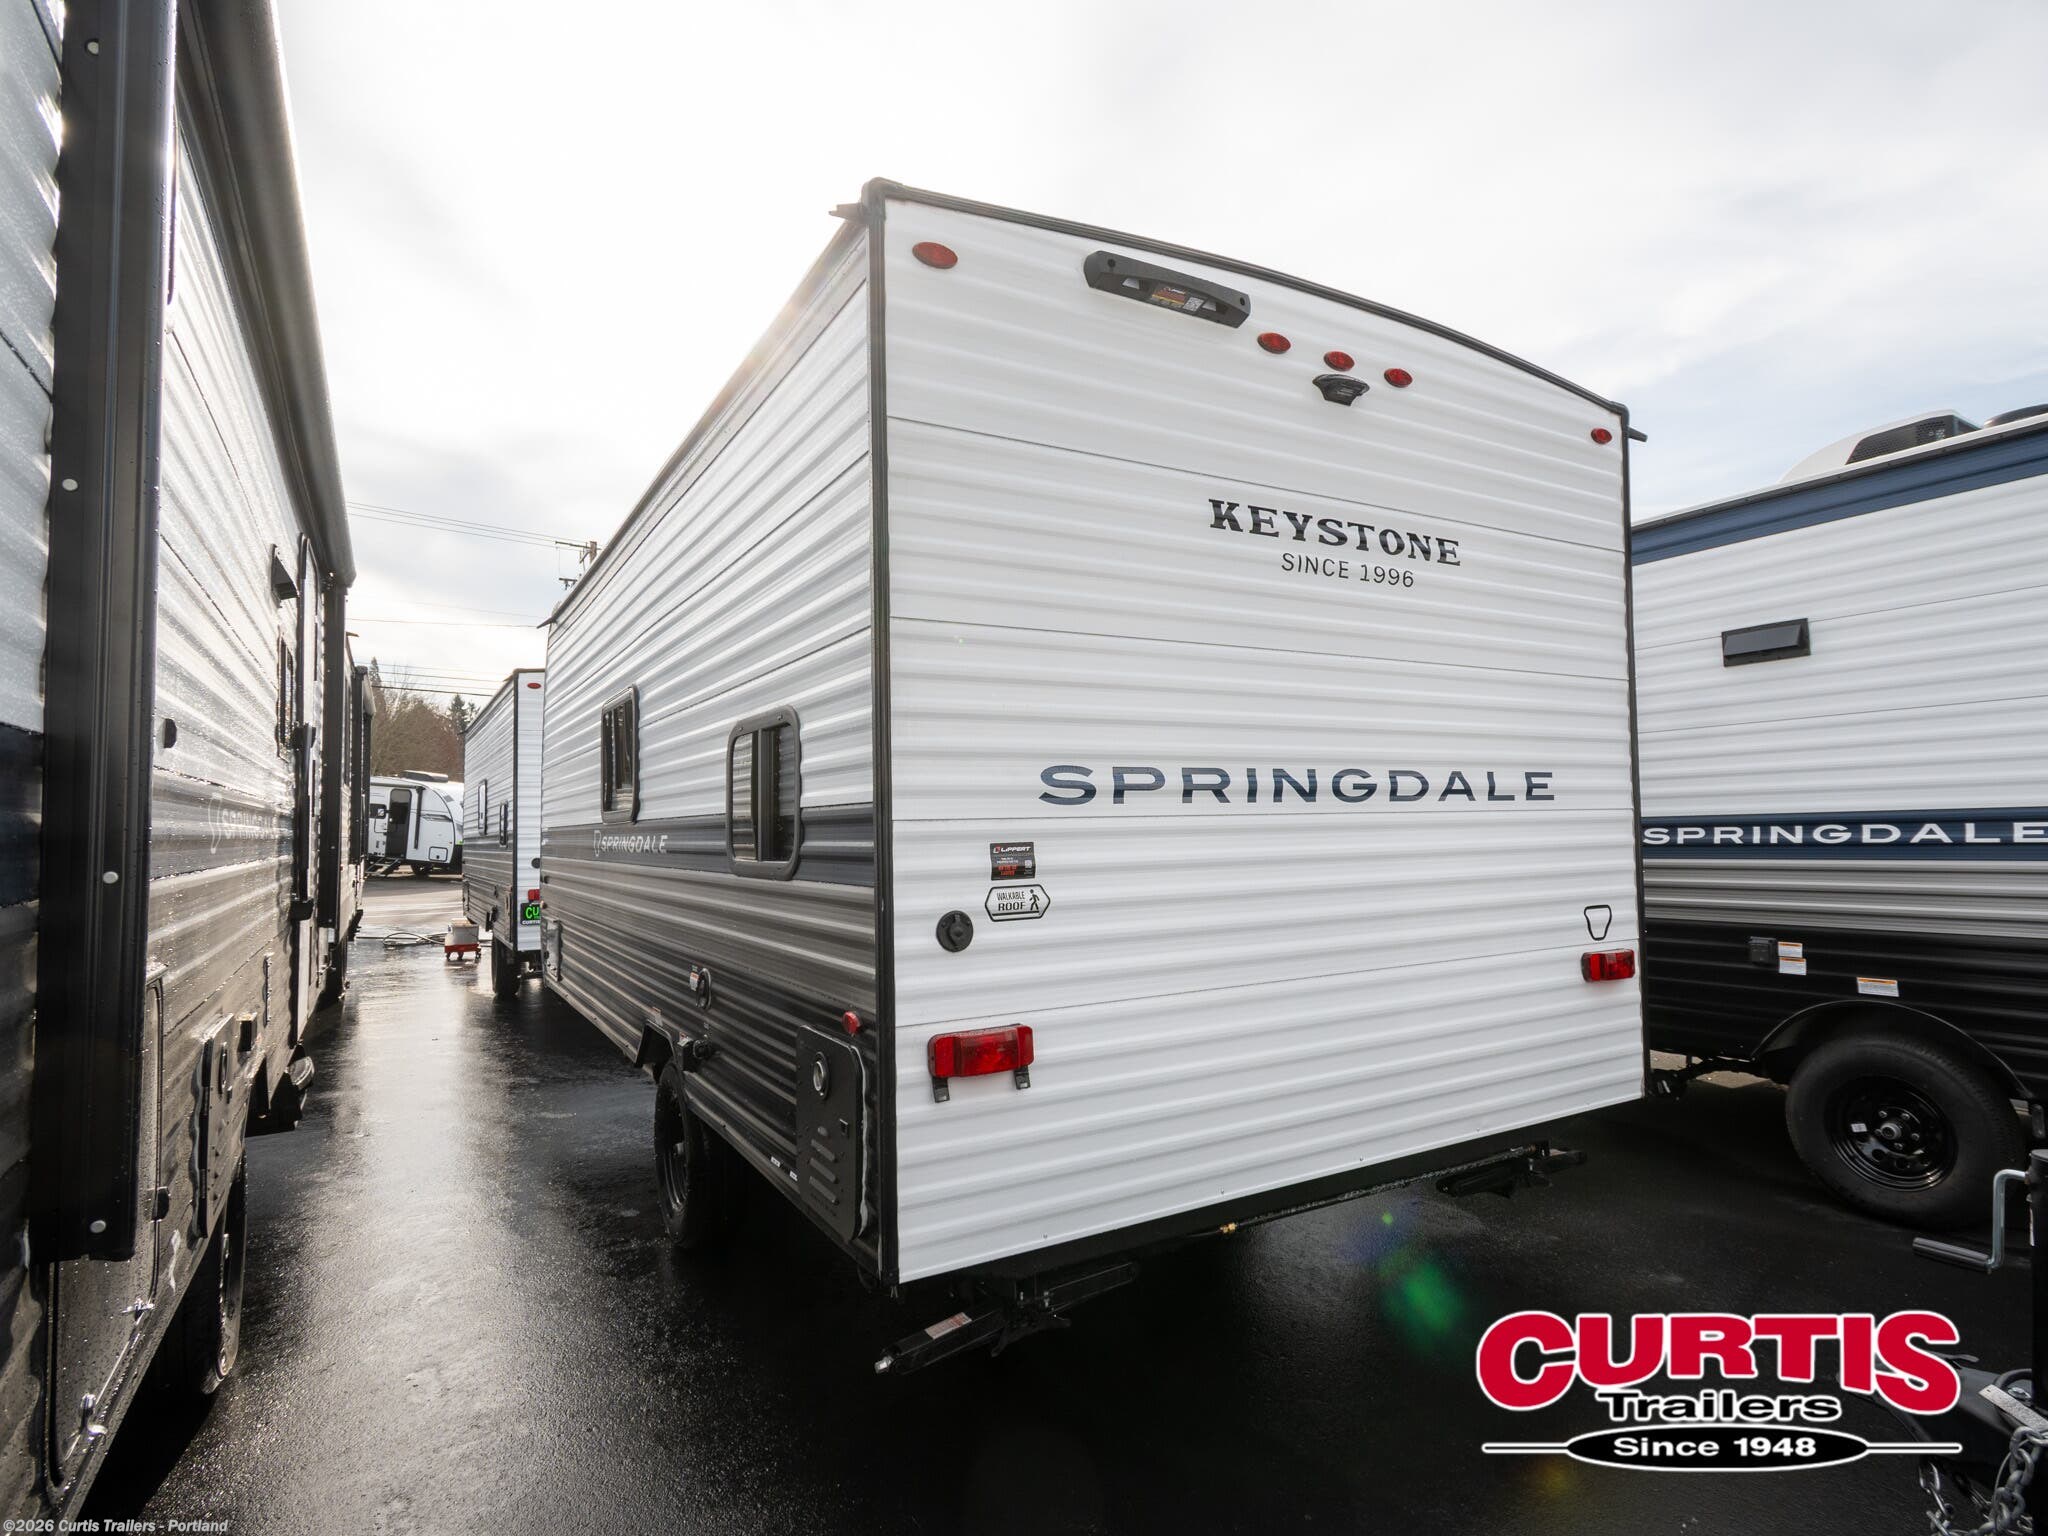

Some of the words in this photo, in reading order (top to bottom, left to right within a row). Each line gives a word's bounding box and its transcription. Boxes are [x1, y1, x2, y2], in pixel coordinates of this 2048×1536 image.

[1208, 498, 1461, 567] KEYSTONE
[1281, 552, 1349, 579] SINCE
[1359, 564, 1415, 588] 1996
[1038, 764, 1556, 806] SPRINGDALE
[601, 834, 668, 854] SPRINGDALE
[1642, 821, 2048, 846] SPRINGDALE
[997, 891, 1026, 901] WALKABLE
[998, 901, 1026, 911] ROOF
